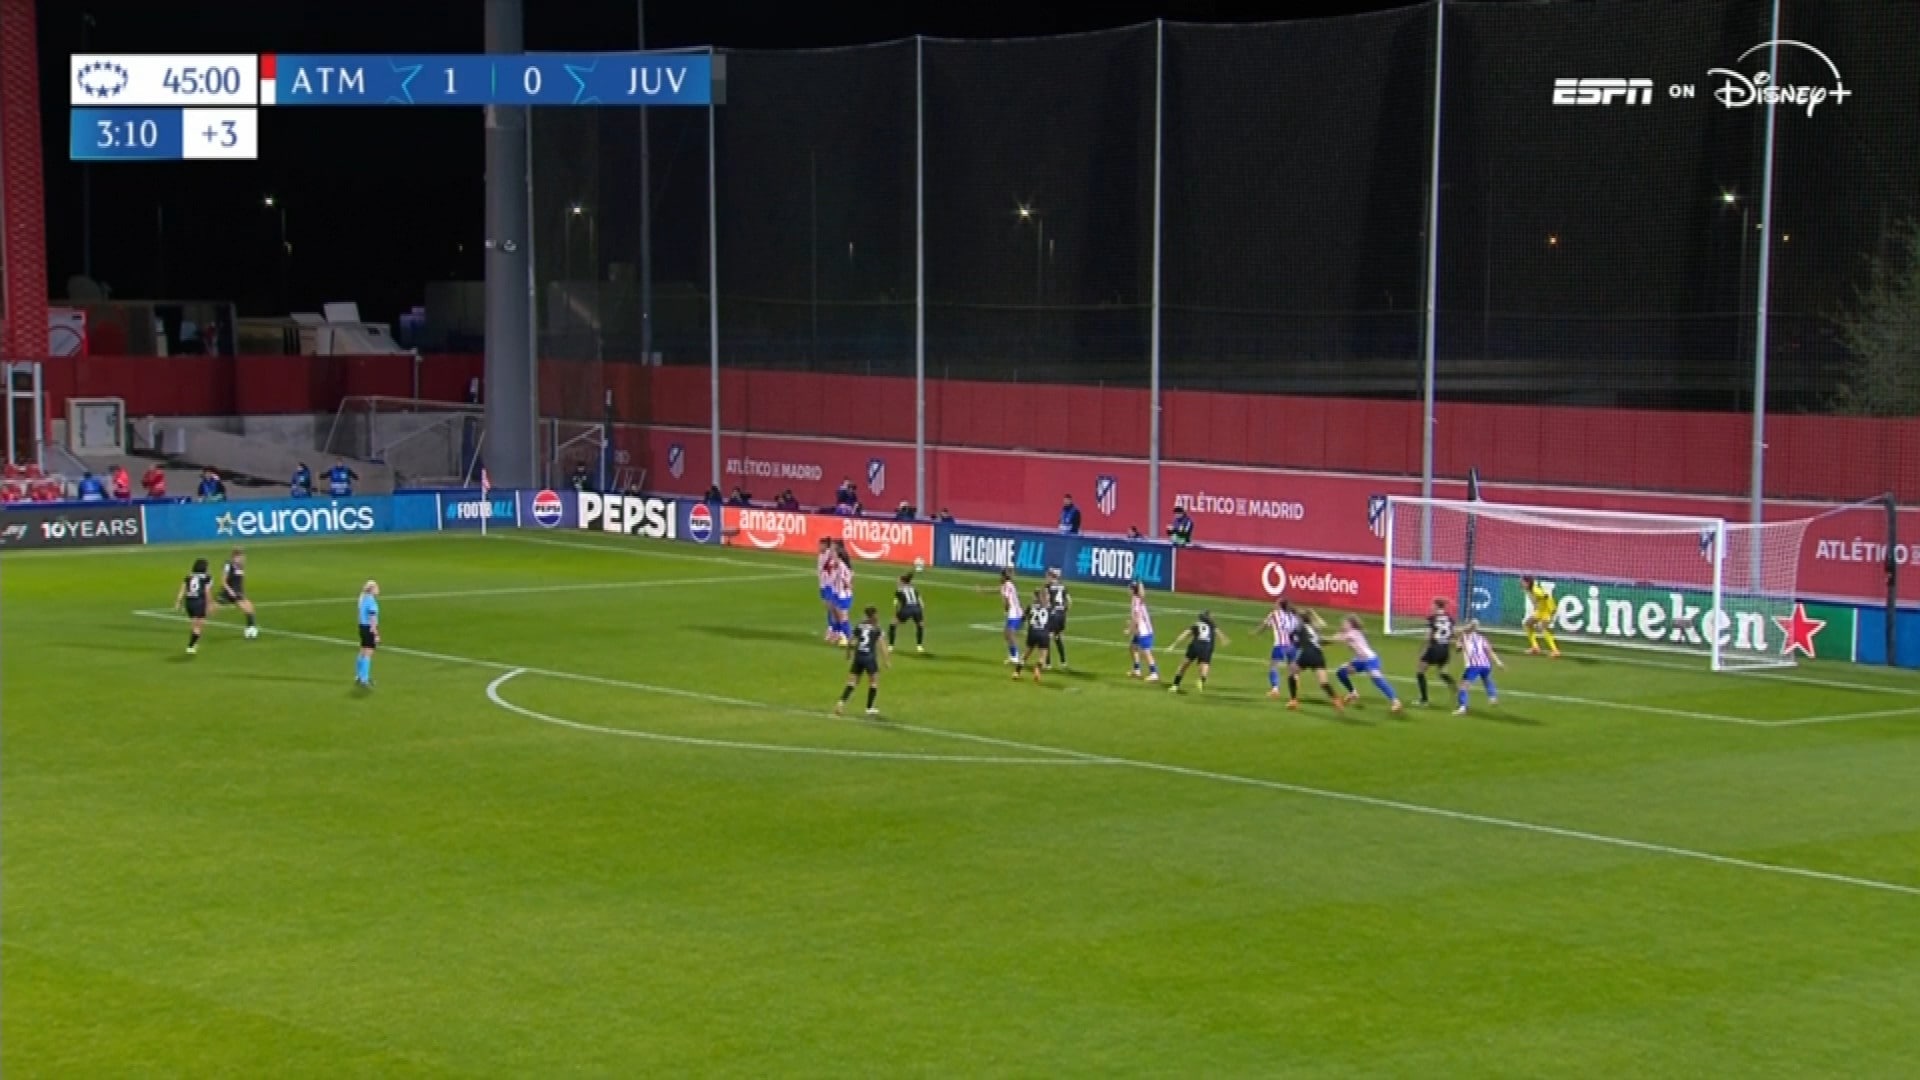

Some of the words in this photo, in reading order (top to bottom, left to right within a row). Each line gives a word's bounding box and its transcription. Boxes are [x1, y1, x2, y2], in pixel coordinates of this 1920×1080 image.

[237, 500, 374, 535] euronics
[578, 491, 677, 539] PEPSI
[1175, 491, 1235, 515] ATLÉTICO
[1250, 499, 1305, 521] MADRID
[739, 509, 807, 536] amazon
[842, 519, 912, 545] amazon
[950, 534, 1015, 568] WELCOME
[1015, 540, 1045, 570] ALL
[1076, 545, 1162, 583] #FOOTBALL
[903, 587, 918, 604] 11
[1289, 572, 1359, 595] vodafone
